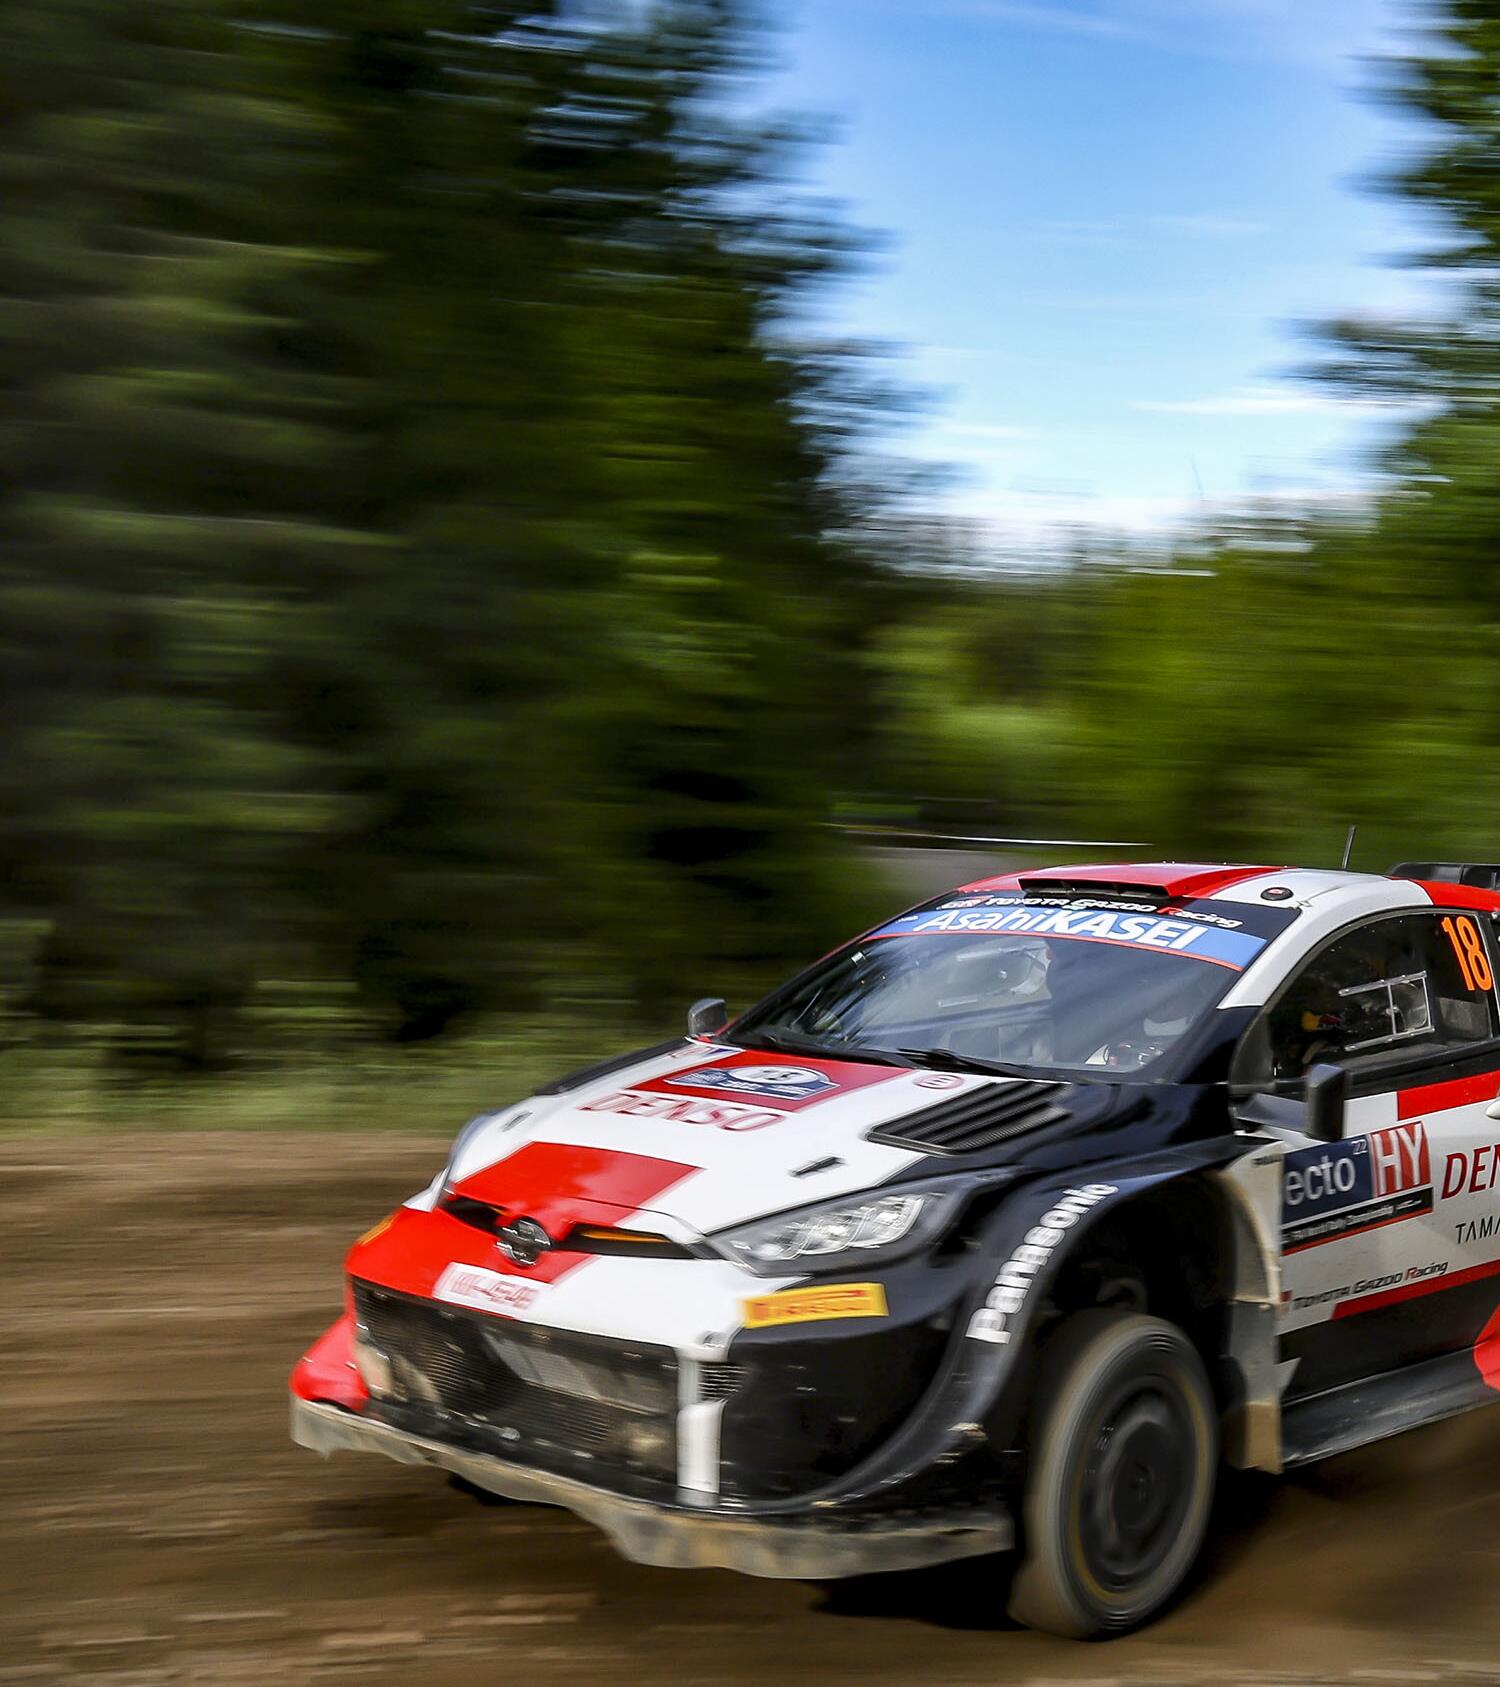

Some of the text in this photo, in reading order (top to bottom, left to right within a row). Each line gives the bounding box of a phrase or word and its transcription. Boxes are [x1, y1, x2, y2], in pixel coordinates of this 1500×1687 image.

[912, 907, 1208, 950] AsahiKASEI
[985, 897, 1069, 907] TOYOTA
[1062, 898, 1157, 912] GAZOO
[1156, 906, 1243, 929] Racing
[1441, 916, 1493, 992] 18
[575, 1092, 787, 1133] DENSO
[1350, 1138, 1368, 1156] 22
[1370, 1123, 1422, 1195] HY
[965, 1184, 1120, 1345] Panasonic
[1353, 1271, 1403, 1295] GAZOO
[1405, 1261, 1449, 1281] Racing
